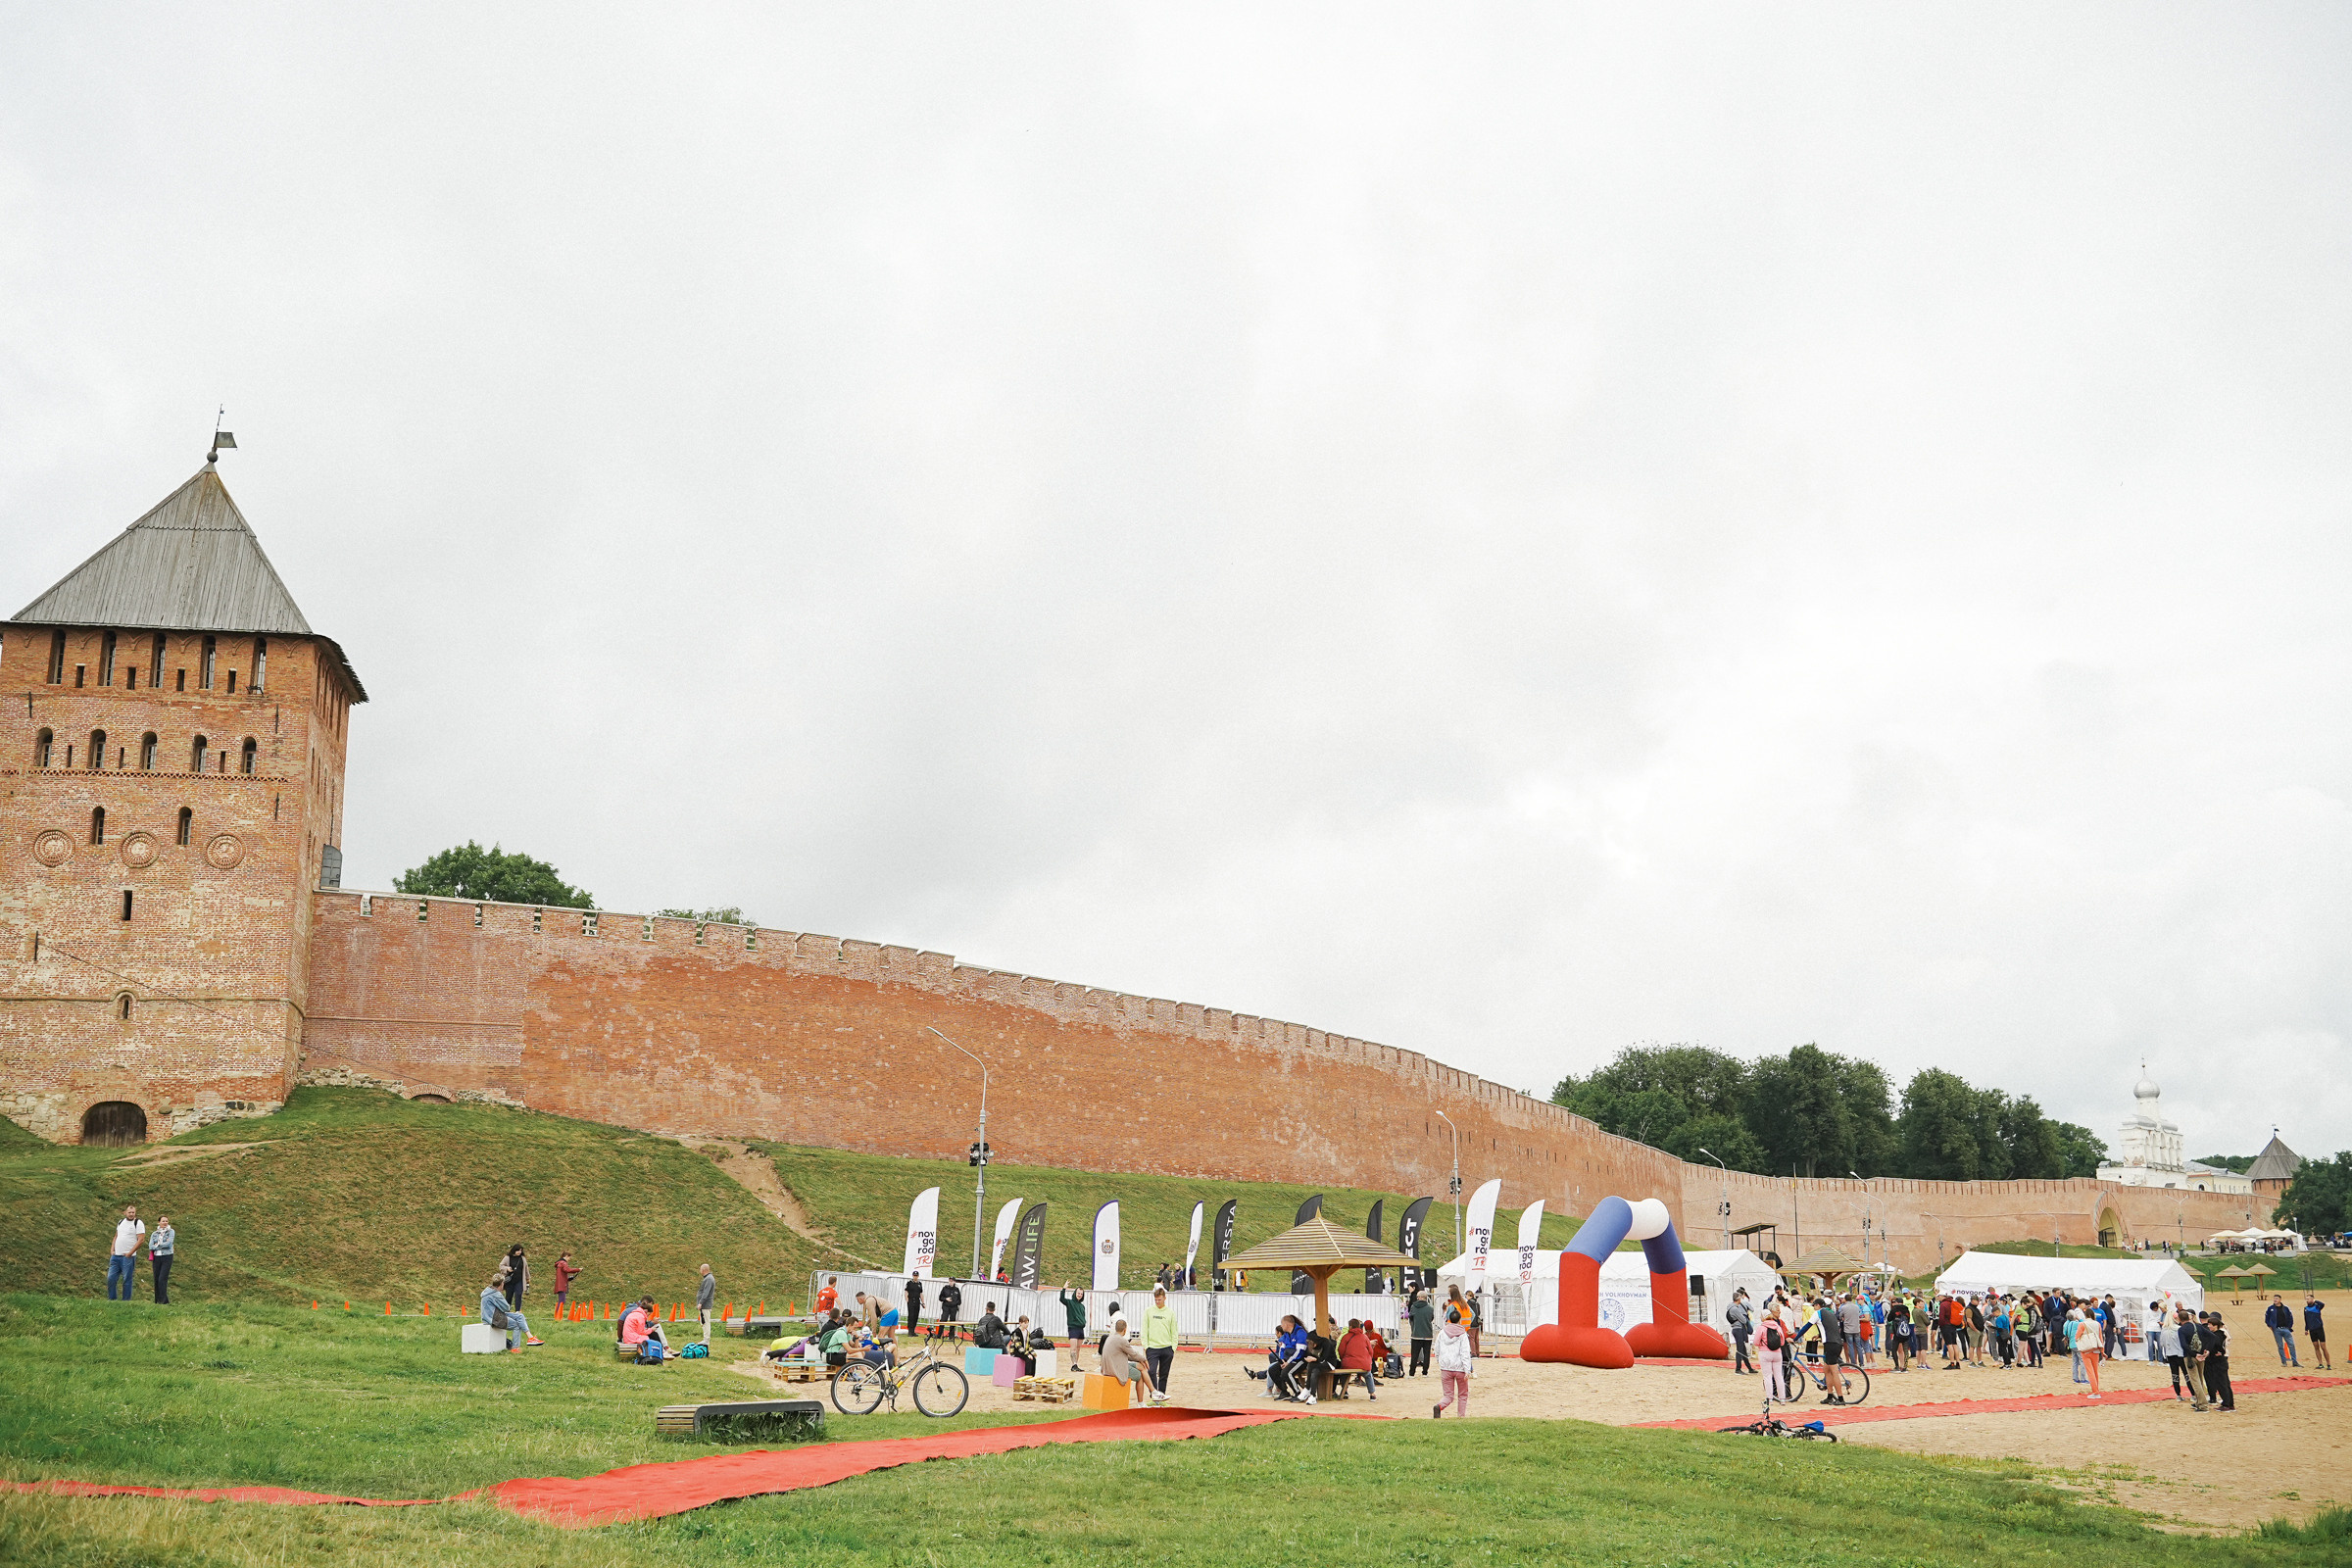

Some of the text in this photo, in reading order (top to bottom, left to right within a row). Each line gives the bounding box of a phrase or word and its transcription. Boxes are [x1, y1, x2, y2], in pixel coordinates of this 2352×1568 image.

[1221, 1205, 1236, 1275] ERSTA
[918, 1245, 934, 1253] rod
[1522, 1252, 1533, 1262] go
[1519, 1259, 1533, 1270] rod
